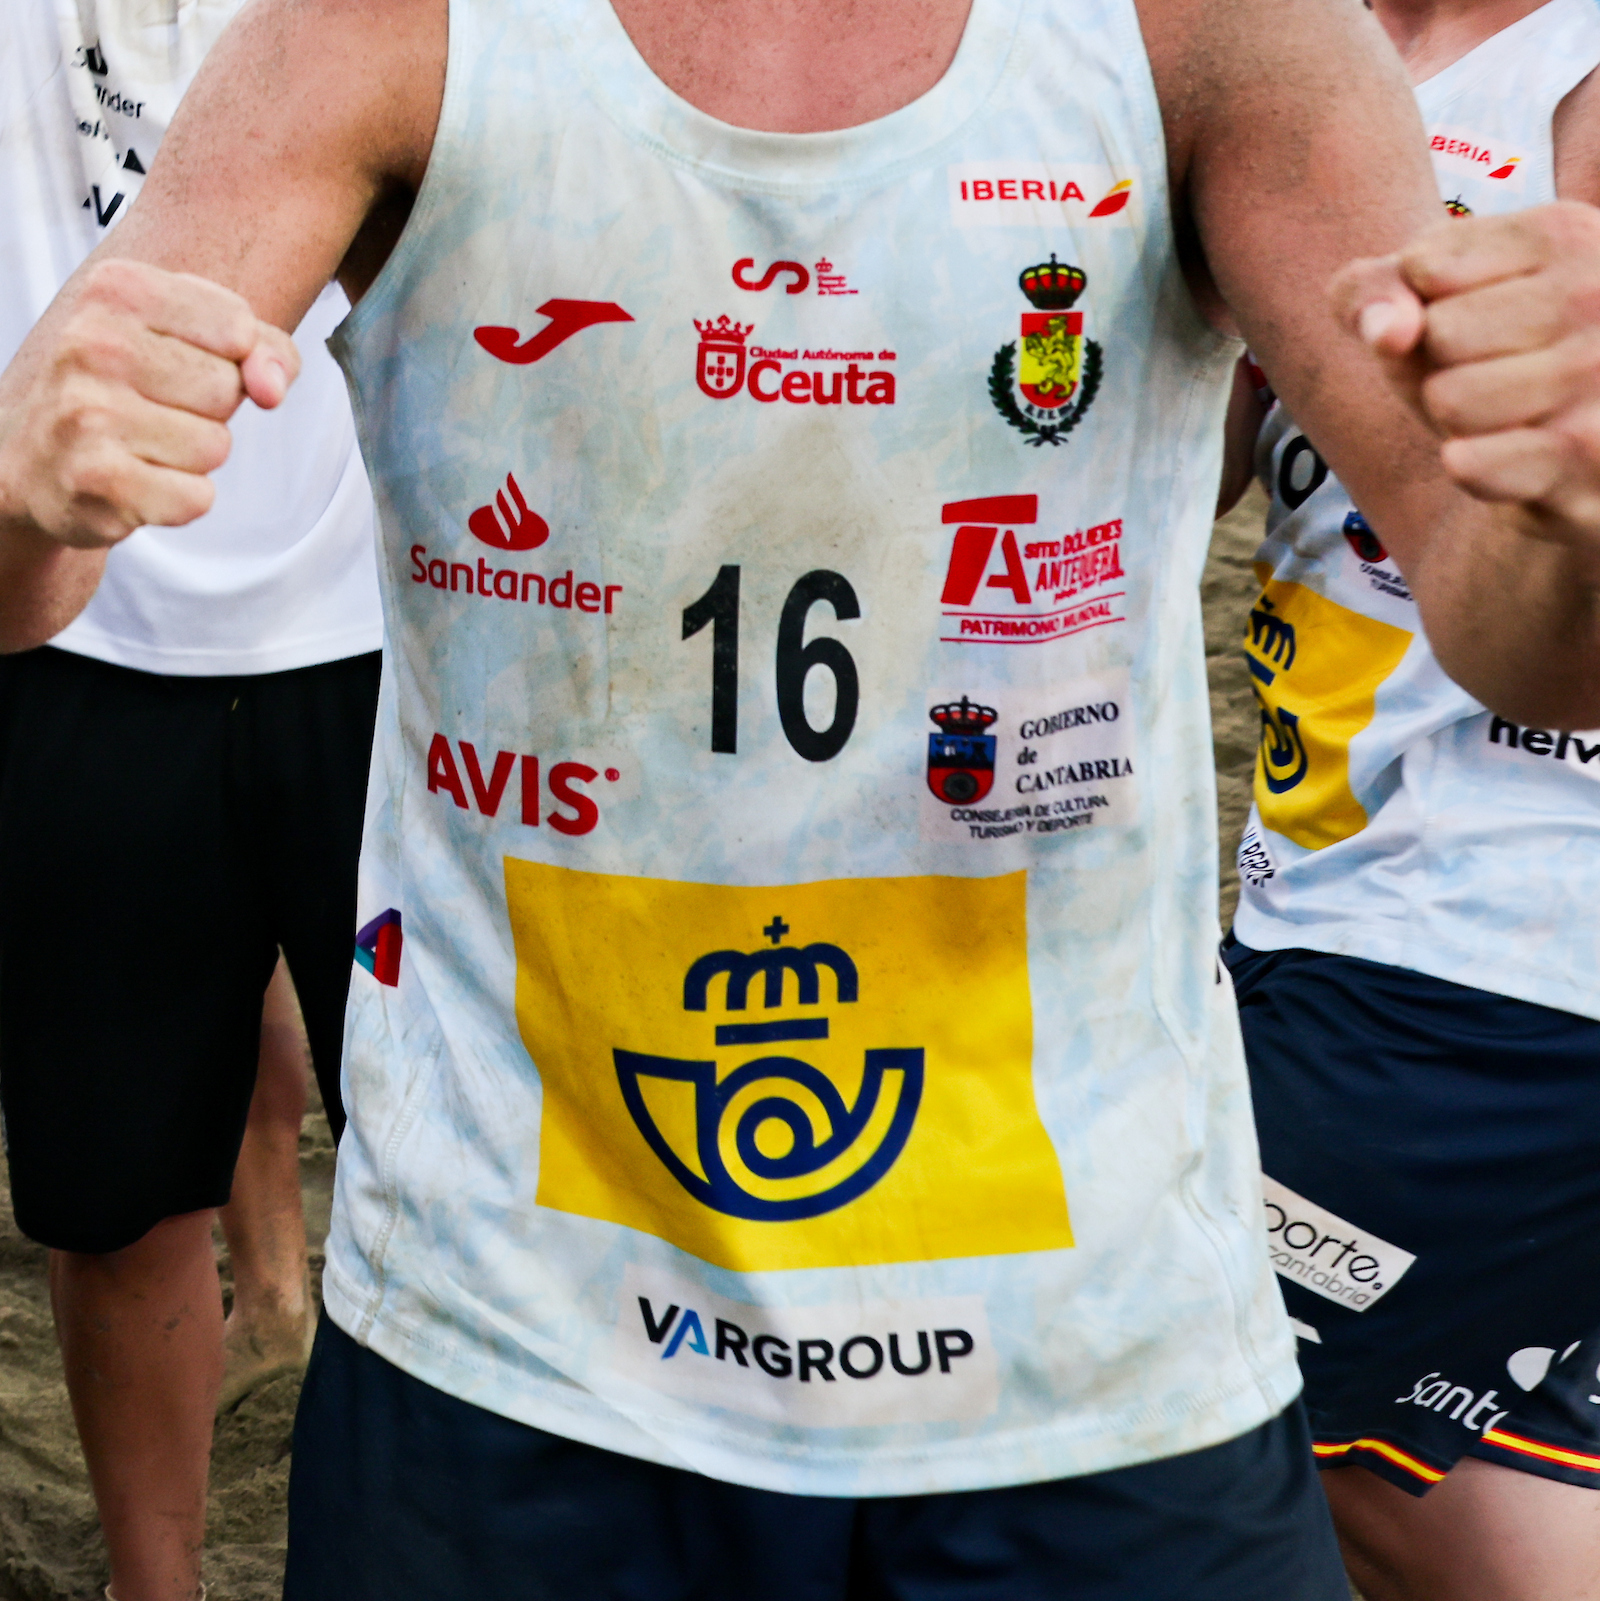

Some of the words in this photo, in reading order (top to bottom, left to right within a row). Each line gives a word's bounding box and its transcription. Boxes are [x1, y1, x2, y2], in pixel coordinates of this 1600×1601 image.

[1429, 134, 1492, 166] BERIA
[960, 179, 1086, 202] IBERIA
[747, 359, 896, 405] Ceuta
[410, 545, 623, 615] Santander
[682, 564, 861, 762] 16
[1019, 701, 1120, 740] GOBIERNO
[1015, 757, 1134, 794] CANTABRIA
[1017, 746, 1038, 766] de
[637, 1296, 975, 1383] VARGROUP
